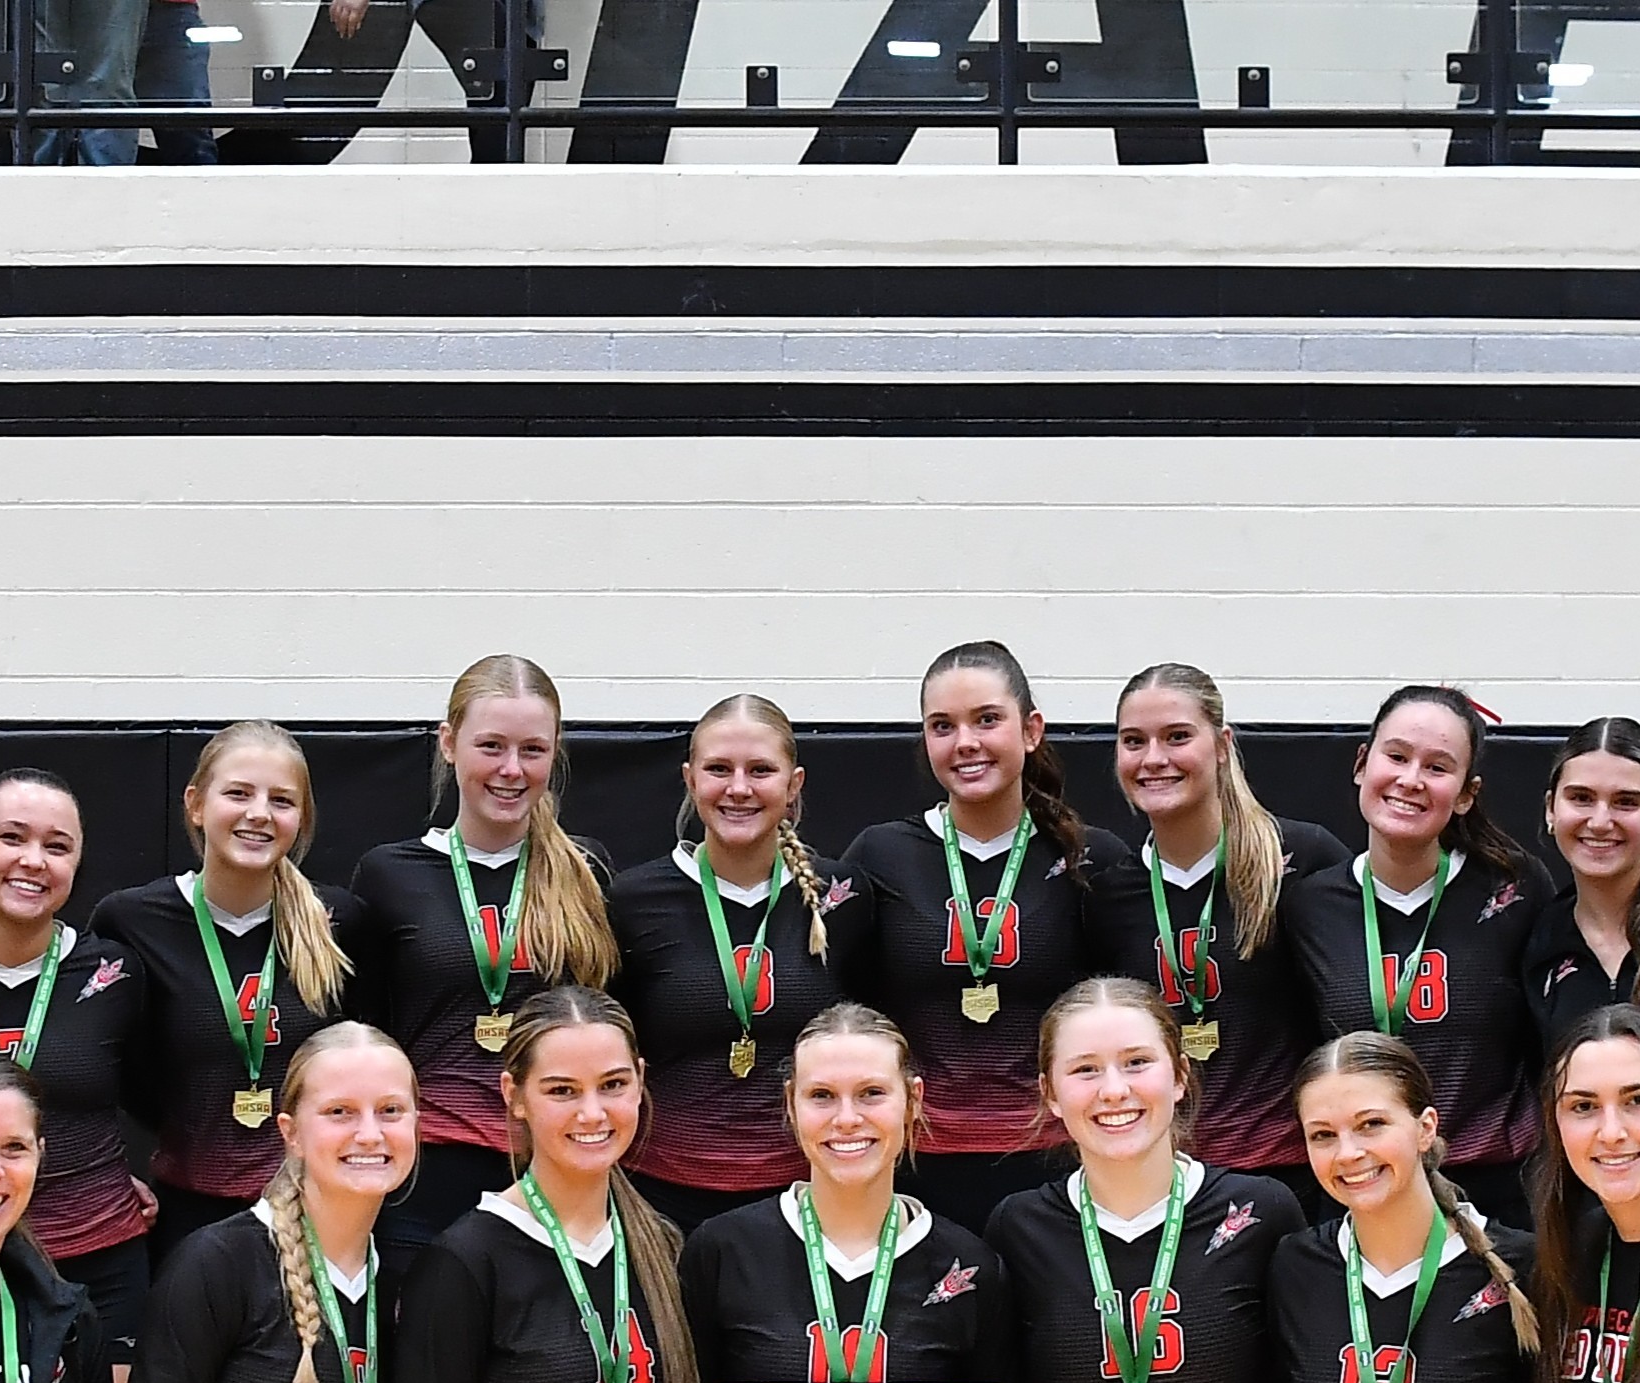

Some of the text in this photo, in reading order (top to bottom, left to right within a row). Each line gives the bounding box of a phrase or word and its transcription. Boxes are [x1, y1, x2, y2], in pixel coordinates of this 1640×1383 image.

[942, 897, 1019, 968] 13
[1154, 925, 1222, 1007] 15
[236, 972, 281, 1046] 4
[1095, 1287, 1184, 1379] 16
